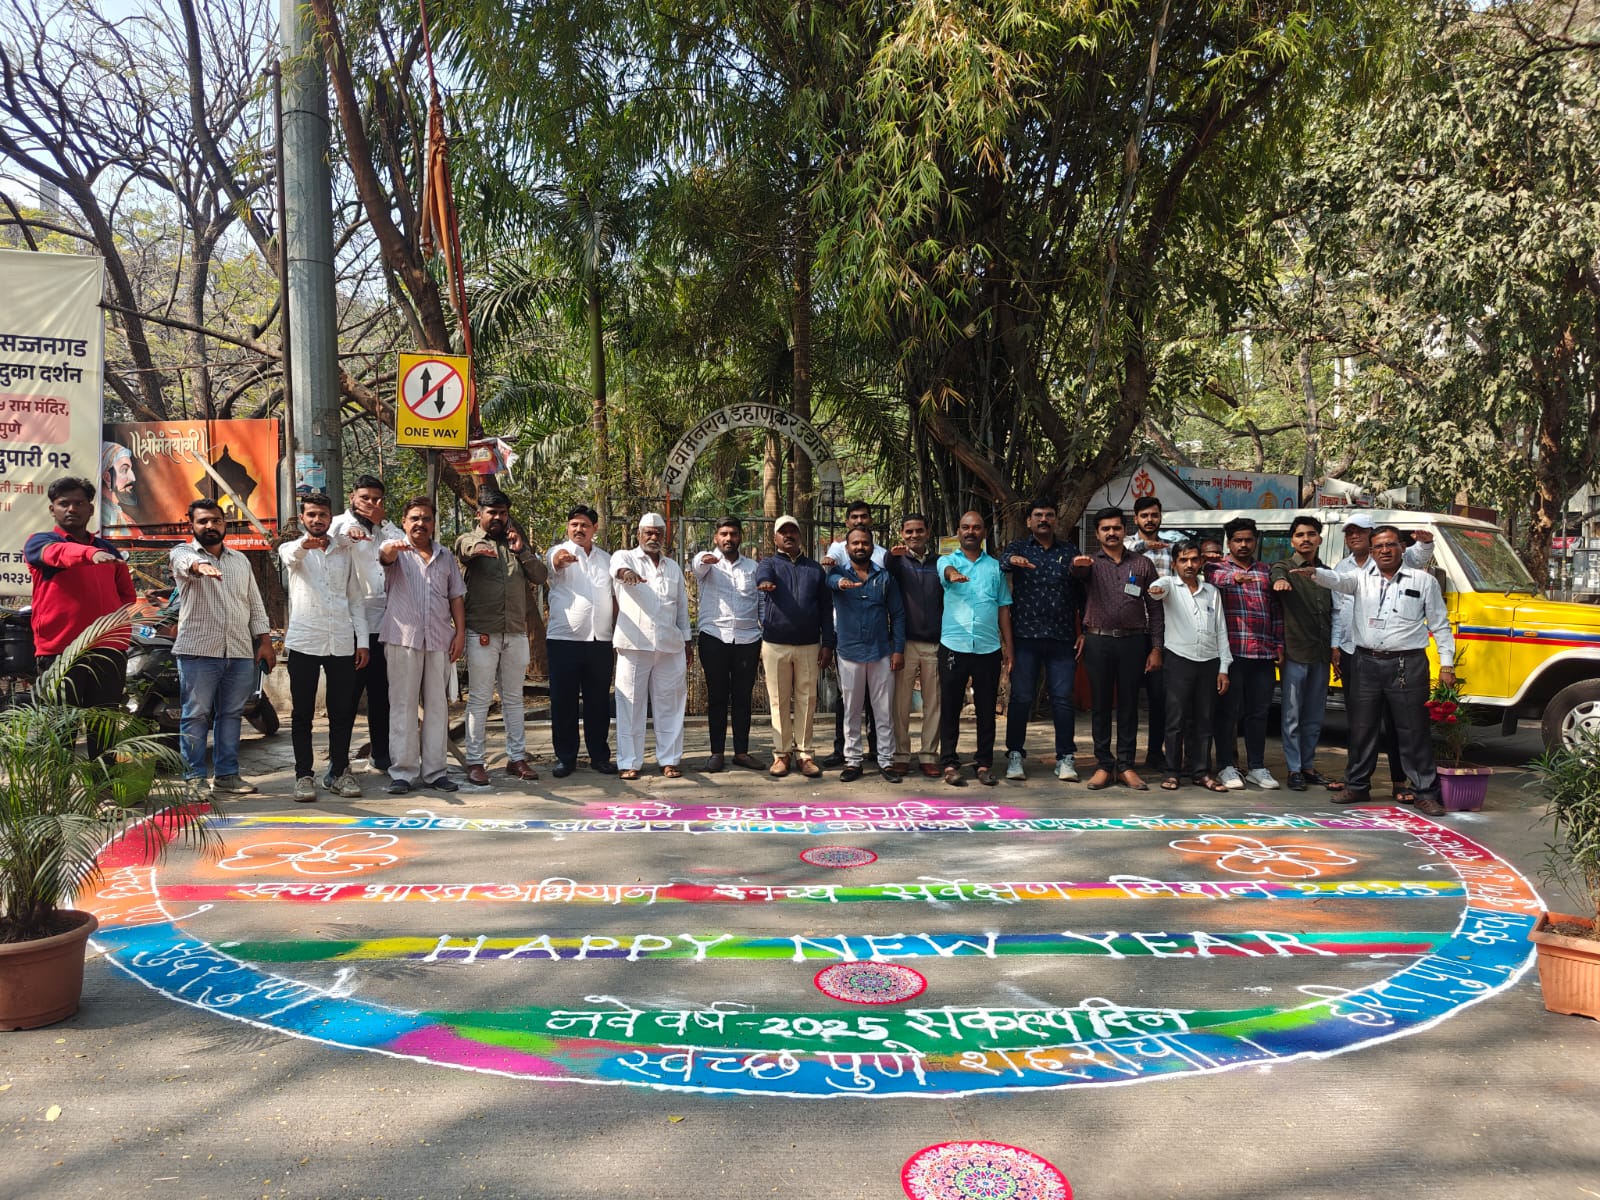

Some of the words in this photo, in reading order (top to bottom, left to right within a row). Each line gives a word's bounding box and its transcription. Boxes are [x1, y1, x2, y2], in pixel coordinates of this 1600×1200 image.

[39, 362, 83, 383] दर्शन
[9, 400, 31, 413] राम
[35, 398, 69, 417] मंदिर,
[404, 427, 430, 438] ONE
[433, 429, 459, 439] WAY
[48, 452, 71, 469] १२
[607, 801, 681, 822] पुणे
[362, 883, 495, 903] भारत
[480, 877, 673, 904] अभियान
[1294, 881, 1440, 897] 2025
[422, 933, 734, 963] HAPPY
[791, 932, 1000, 963] NEW
[1060, 930, 1338, 961] YEAR
[617, 1044, 804, 1082] स्वच्छ
[812, 1040, 928, 1092] पुणे
